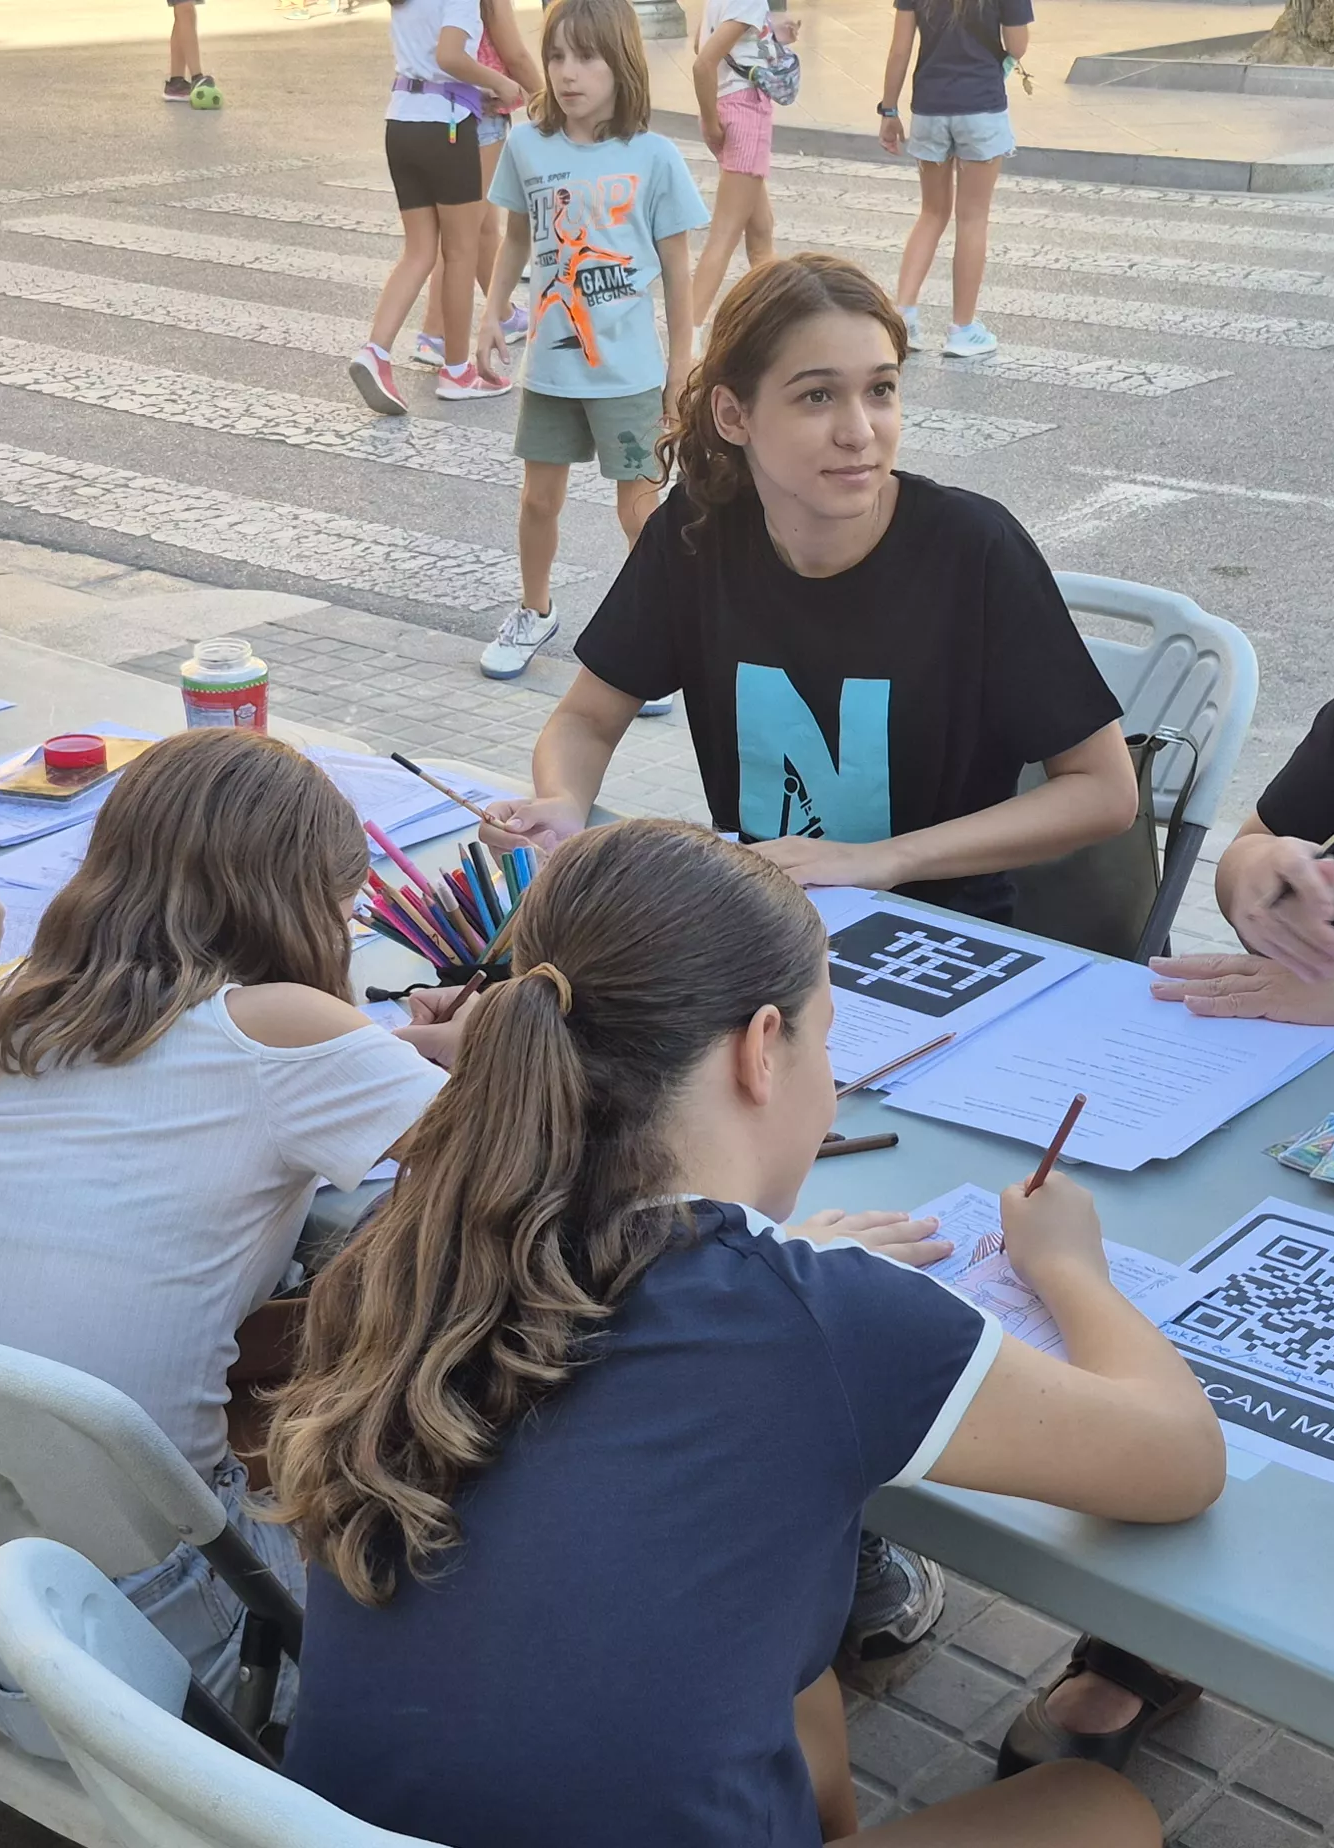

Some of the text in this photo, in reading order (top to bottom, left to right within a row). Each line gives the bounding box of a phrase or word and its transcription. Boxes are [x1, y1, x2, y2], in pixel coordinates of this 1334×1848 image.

[528, 174, 641, 243] TOP
[580, 264, 631, 295] GAME
[586, 284, 637, 308] BEGINS
[736, 661, 892, 845] N
